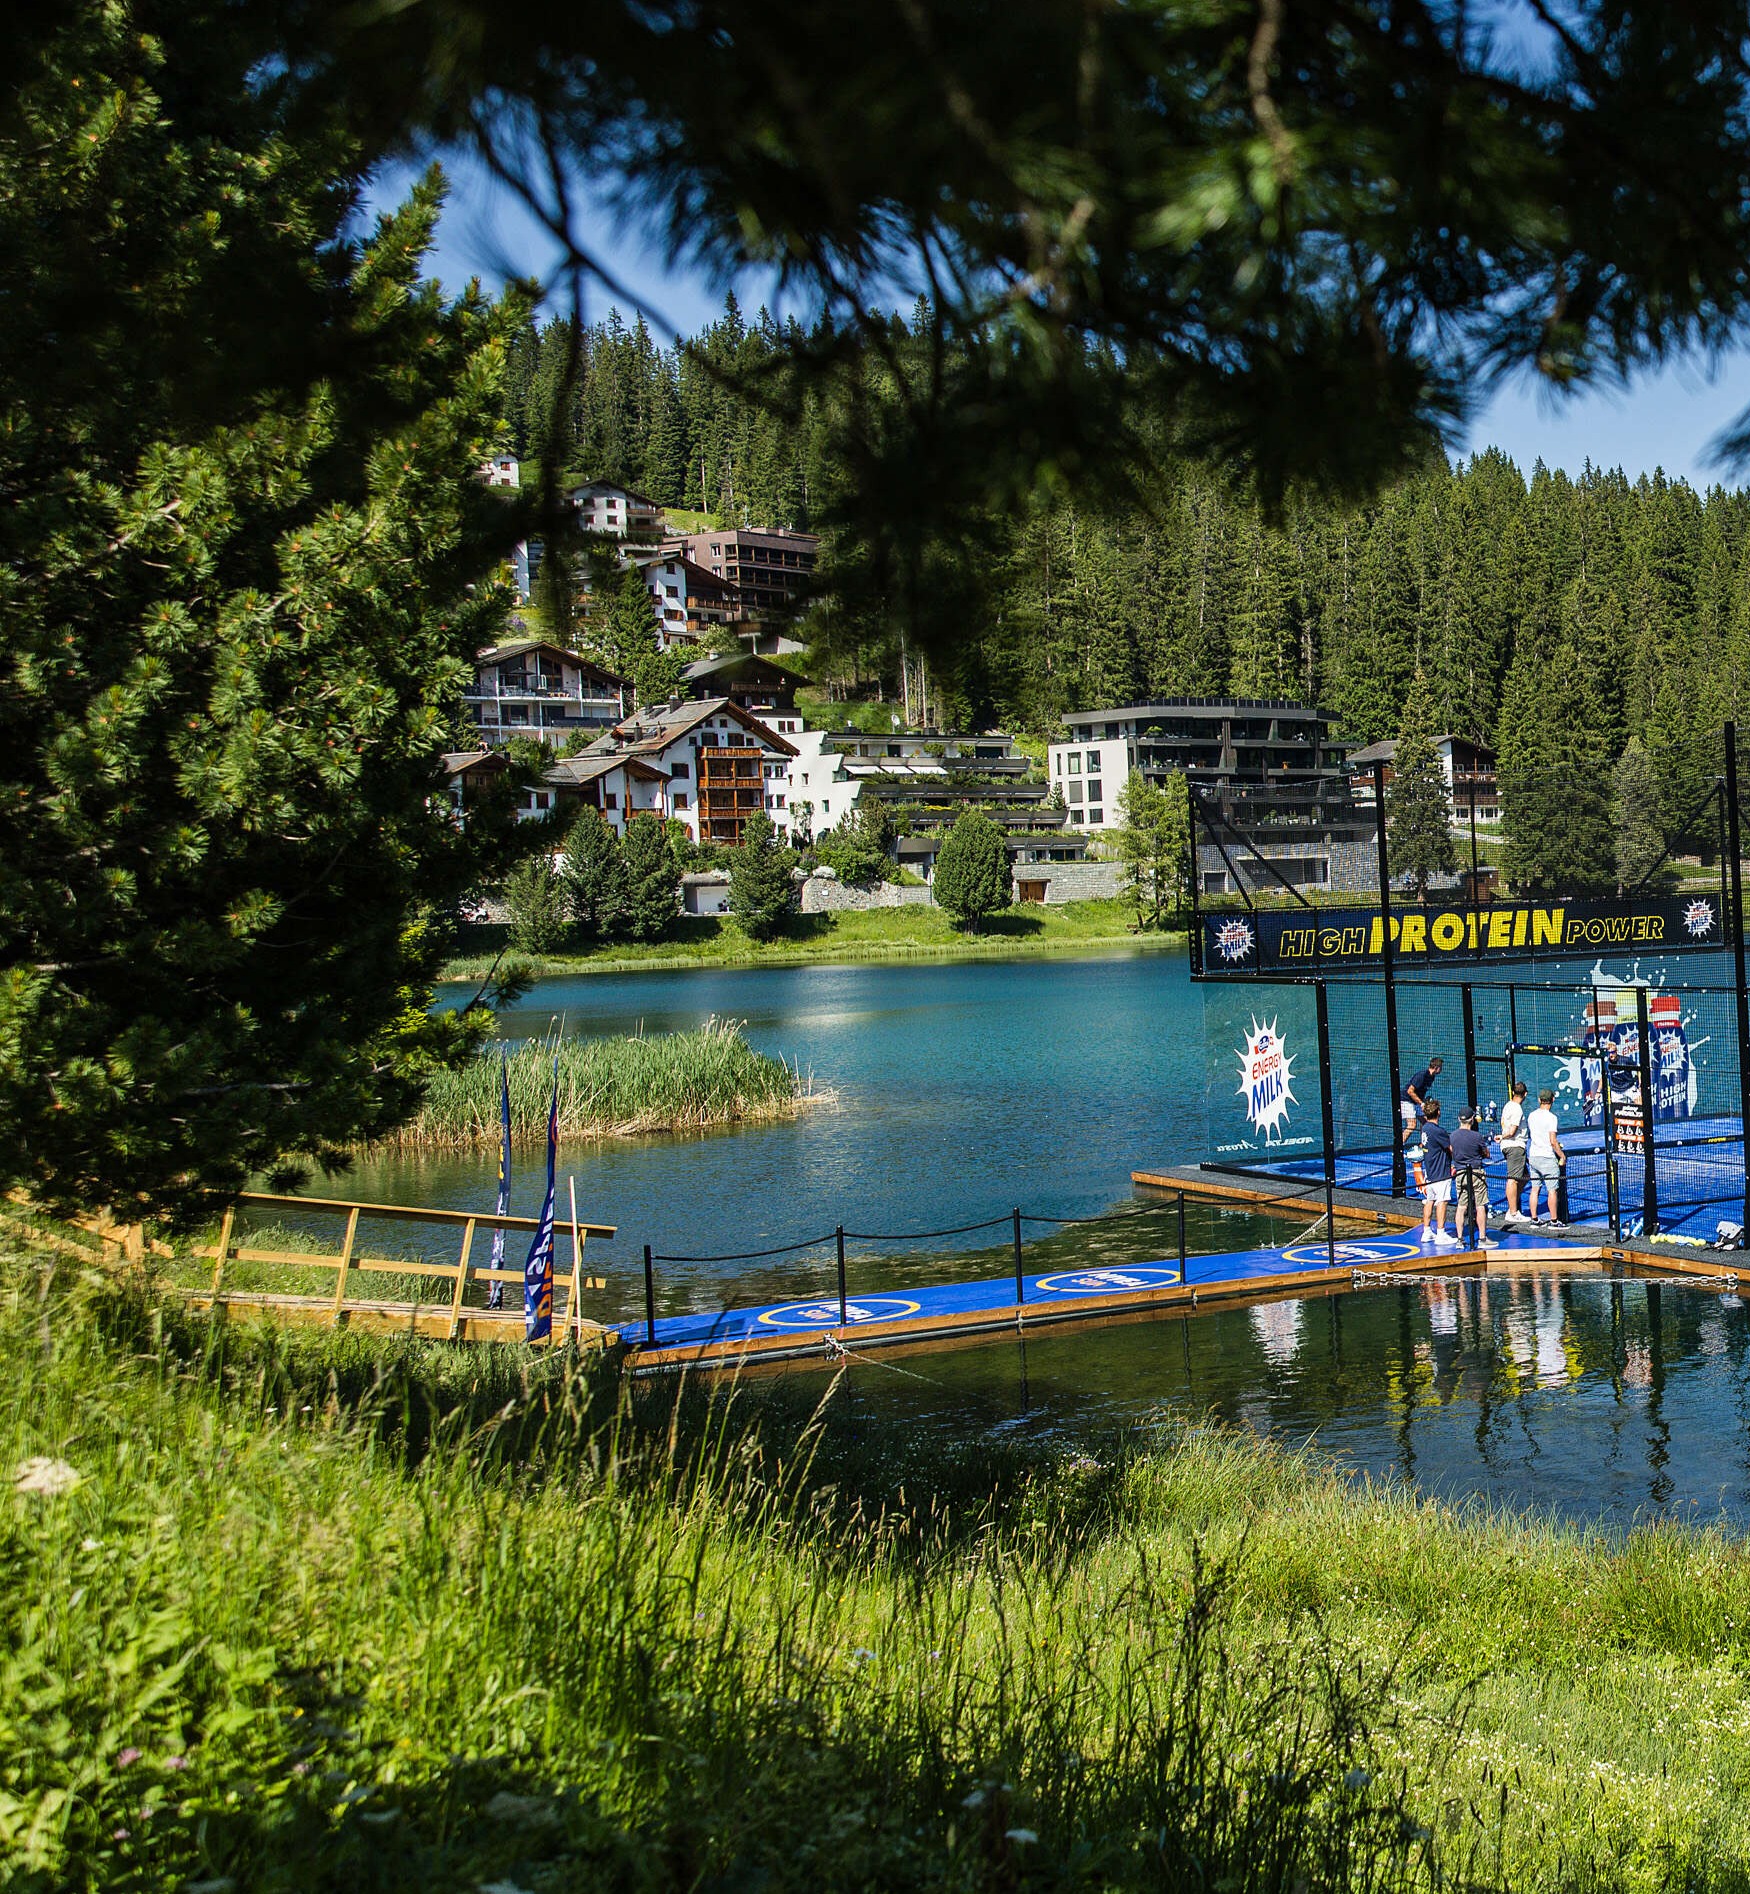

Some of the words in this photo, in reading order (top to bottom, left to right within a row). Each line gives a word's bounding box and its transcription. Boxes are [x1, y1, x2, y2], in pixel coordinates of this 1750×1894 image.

[1280, 928, 1366, 958] HIGH
[1368, 908, 1565, 954] PROTEIN
[1566, 916, 1665, 944] POWER
[1252, 1052, 1282, 1080] ENERGY
[1252, 1069, 1283, 1119] MILK
[1659, 1091, 1687, 1110] OTEIN
